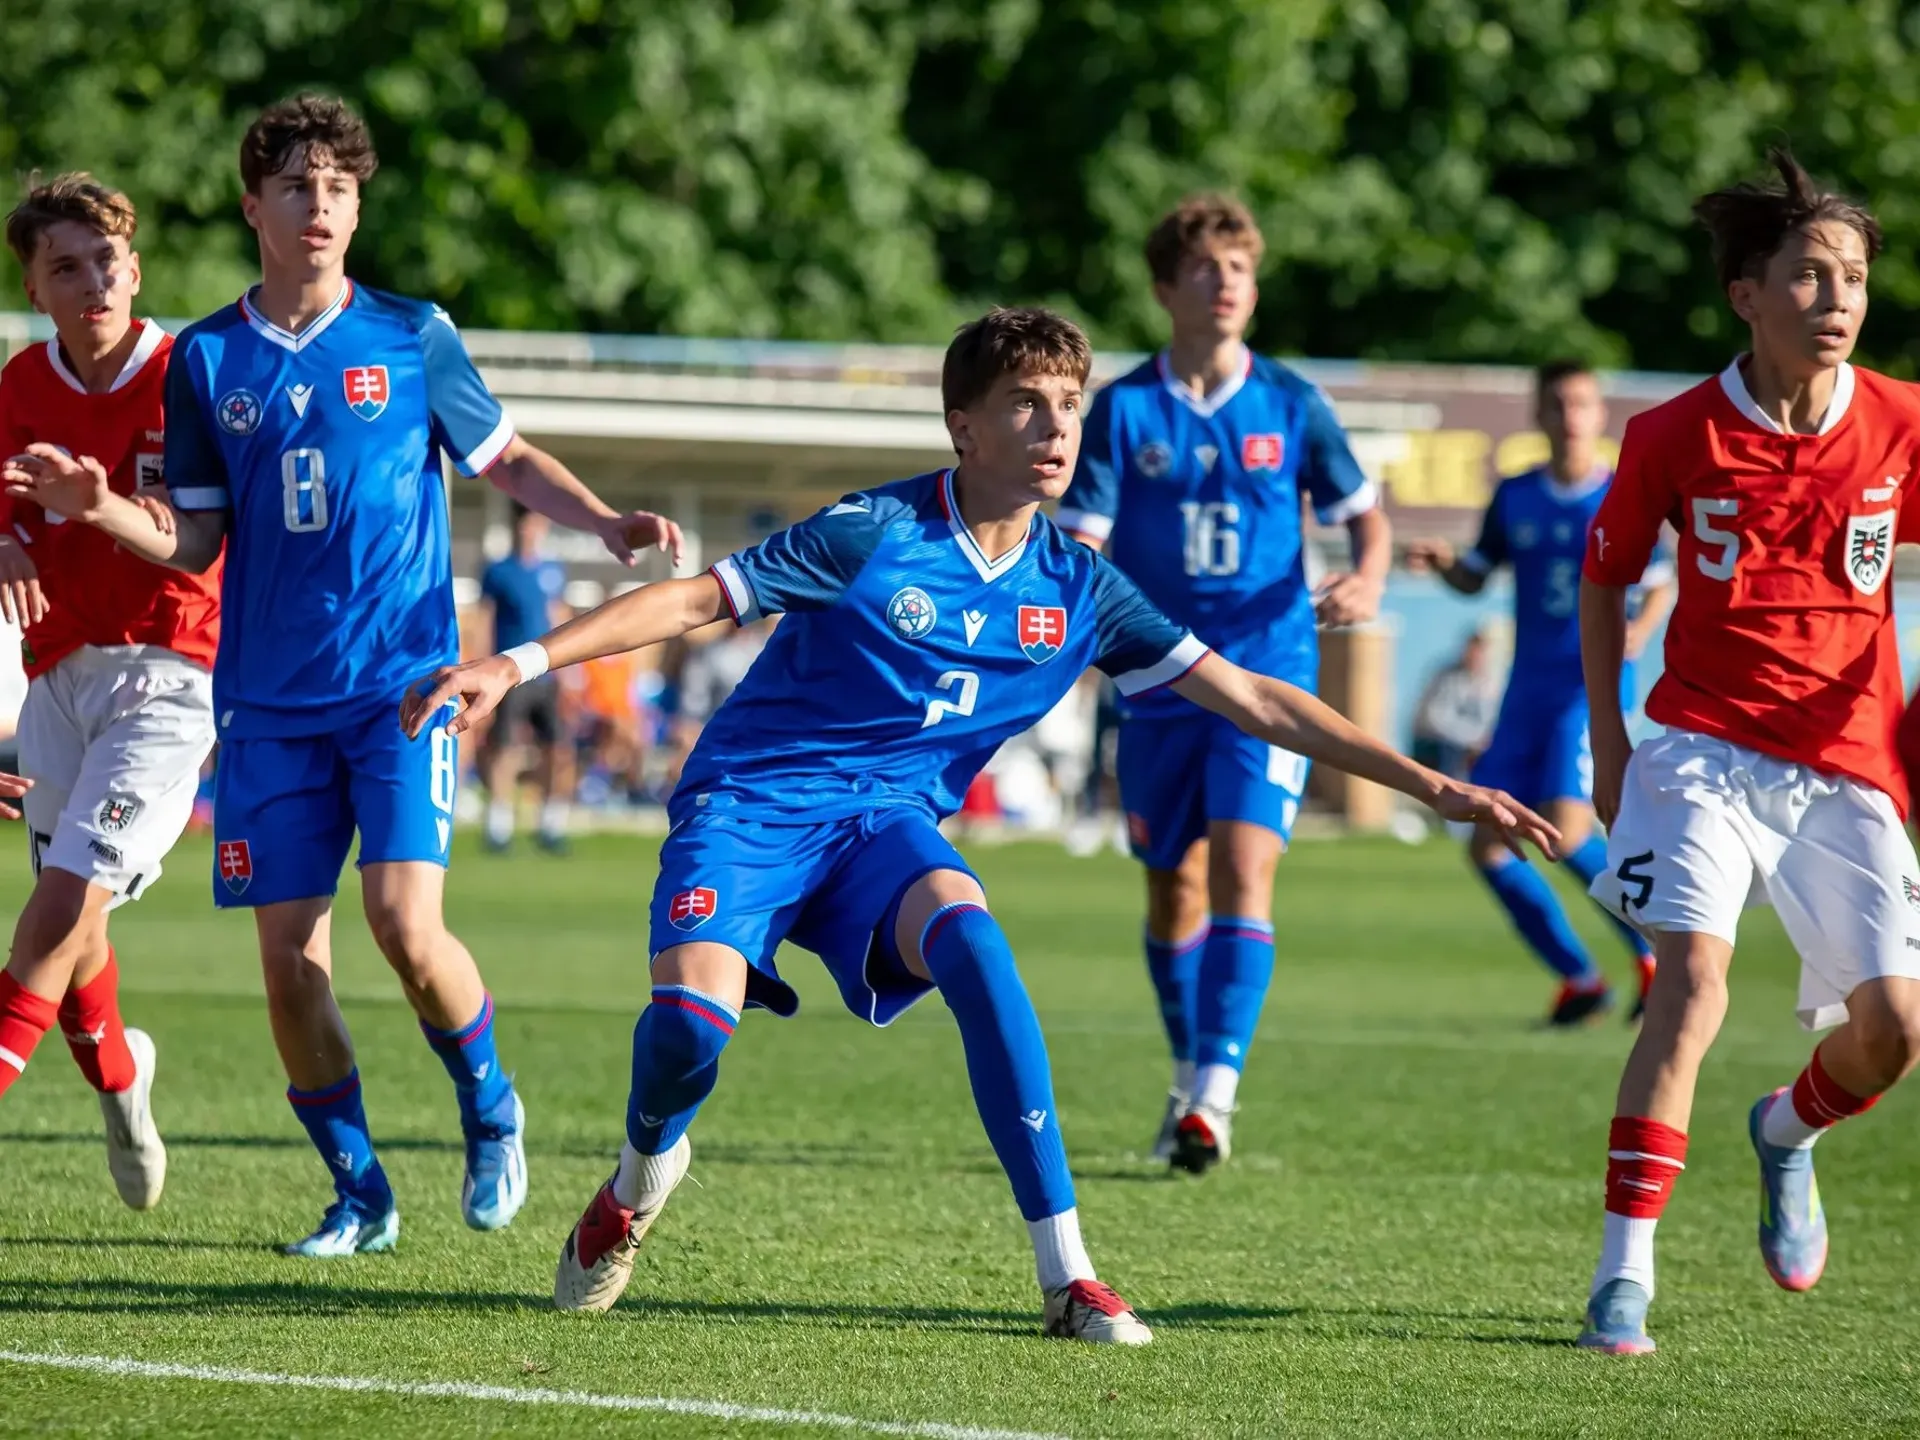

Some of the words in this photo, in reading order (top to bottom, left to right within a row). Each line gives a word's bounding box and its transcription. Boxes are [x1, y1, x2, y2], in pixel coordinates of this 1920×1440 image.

[281, 448, 328, 533] 8
[1179, 501, 1240, 576] 16
[1692, 497, 1740, 581] 5
[921, 670, 979, 729] 2
[430, 726, 455, 815] 8
[1617, 849, 1655, 914] 5
